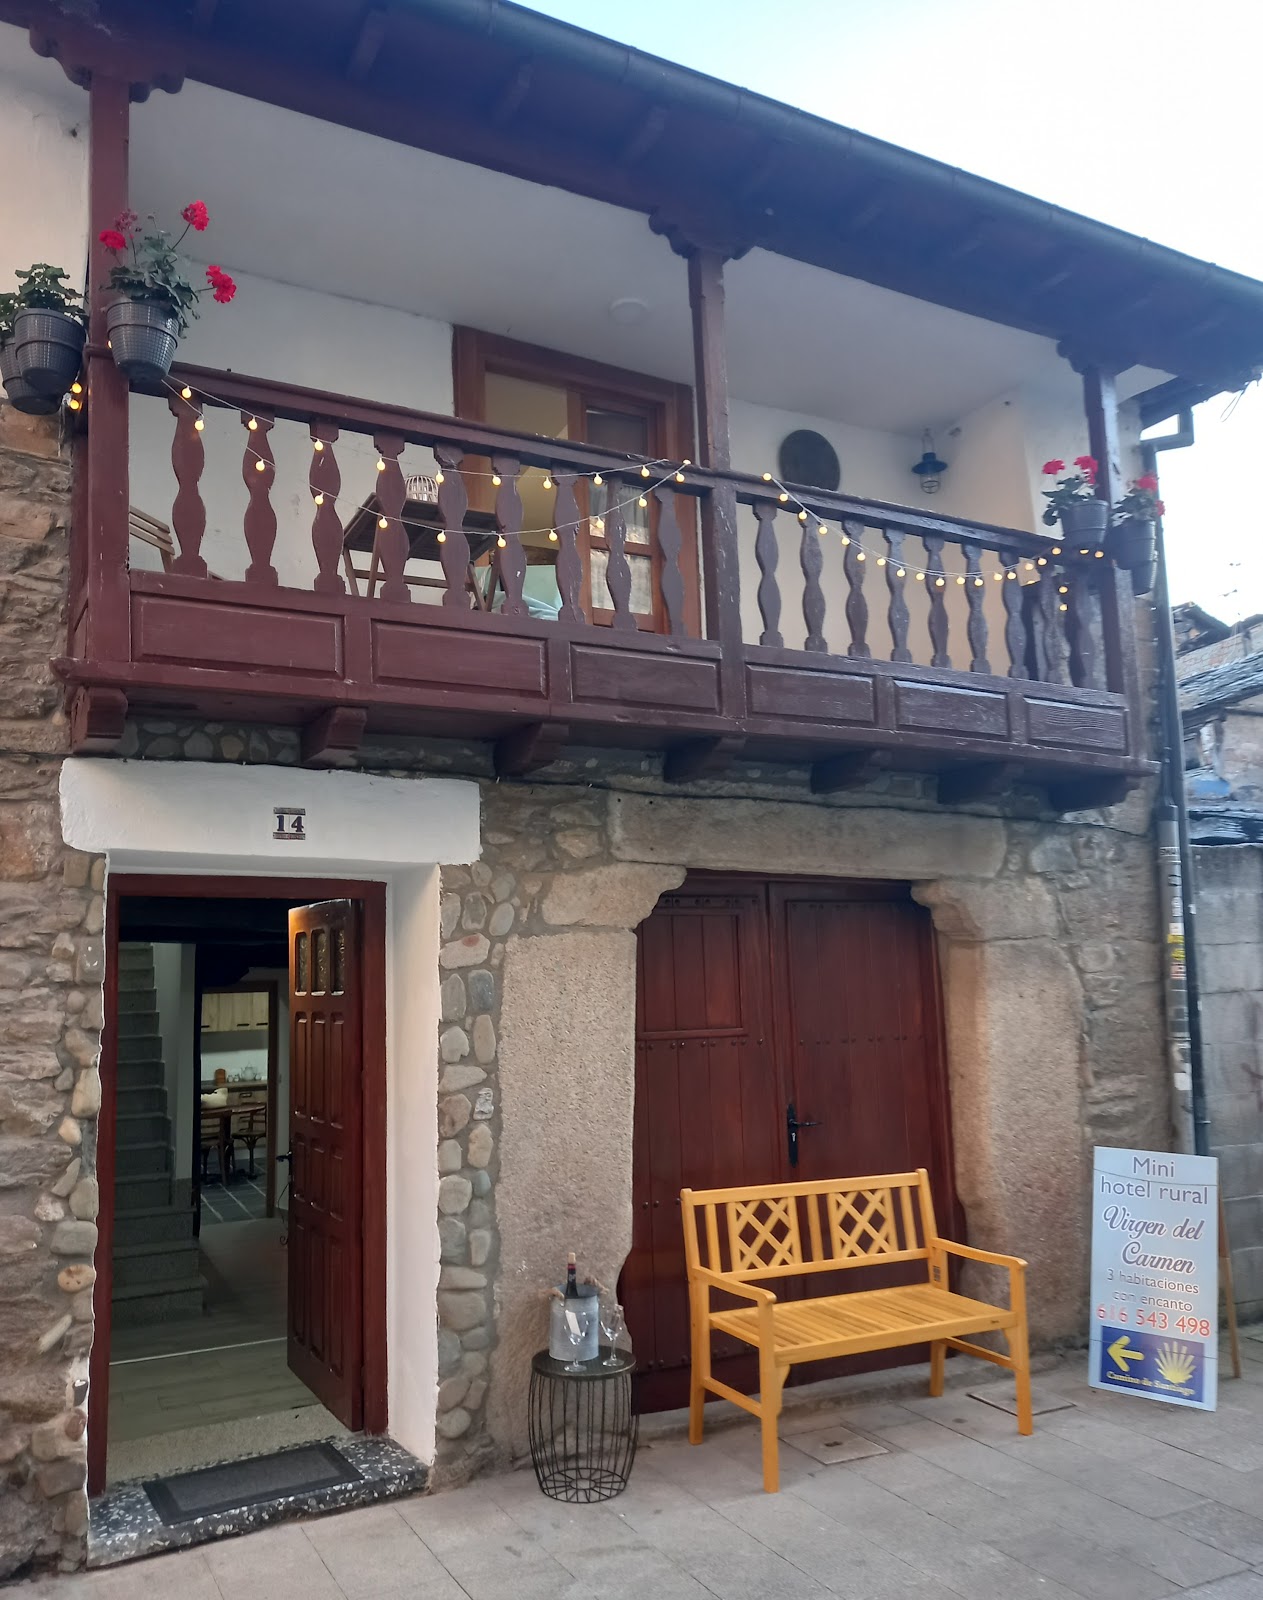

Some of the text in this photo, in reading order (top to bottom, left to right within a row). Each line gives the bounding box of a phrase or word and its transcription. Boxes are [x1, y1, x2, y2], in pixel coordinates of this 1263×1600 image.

[276, 815, 305, 833] 14
[1133, 1156, 1175, 1178] Mini
[1101, 1175, 1208, 1205] hotel rural
[1103, 1205, 1205, 1240] Virgen del
[1121, 1241, 1195, 1274] Carmen
[1107, 1268, 1199, 1294] 3 habitaciones
[1140, 1295, 1193, 1312] encanto
[1096, 1303, 1211, 1337] 616 543 498
